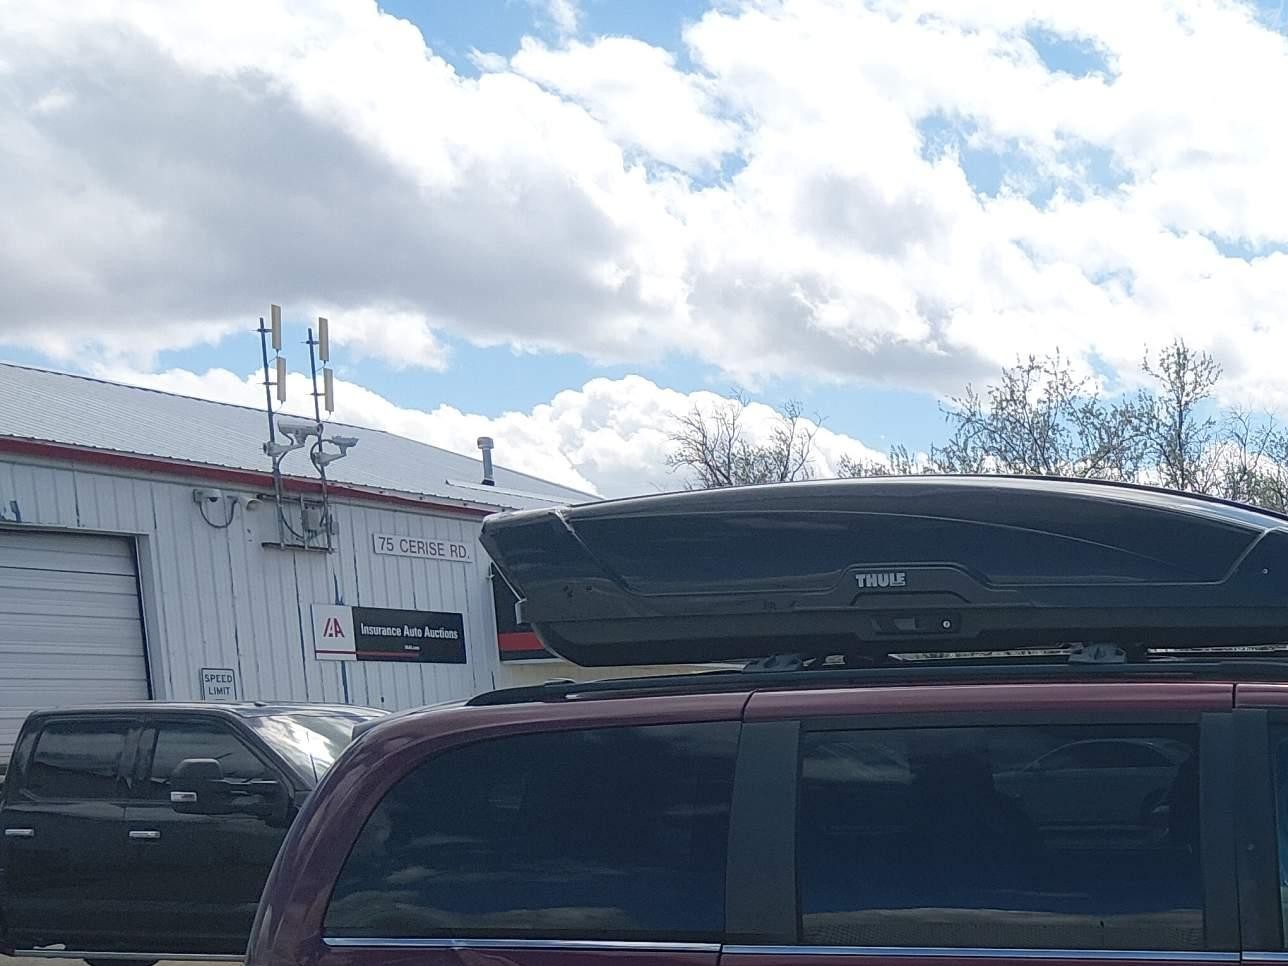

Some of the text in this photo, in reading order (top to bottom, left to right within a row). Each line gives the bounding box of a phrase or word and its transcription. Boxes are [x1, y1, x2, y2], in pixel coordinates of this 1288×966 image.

[378, 536, 470, 559] 75 CERISE RD.
[855, 573, 906, 587] THULE
[360, 622, 459, 640] Insurance Auto Auctions
[204, 674, 232, 683] SPEED
[209, 686, 230, 695] LIMIT
